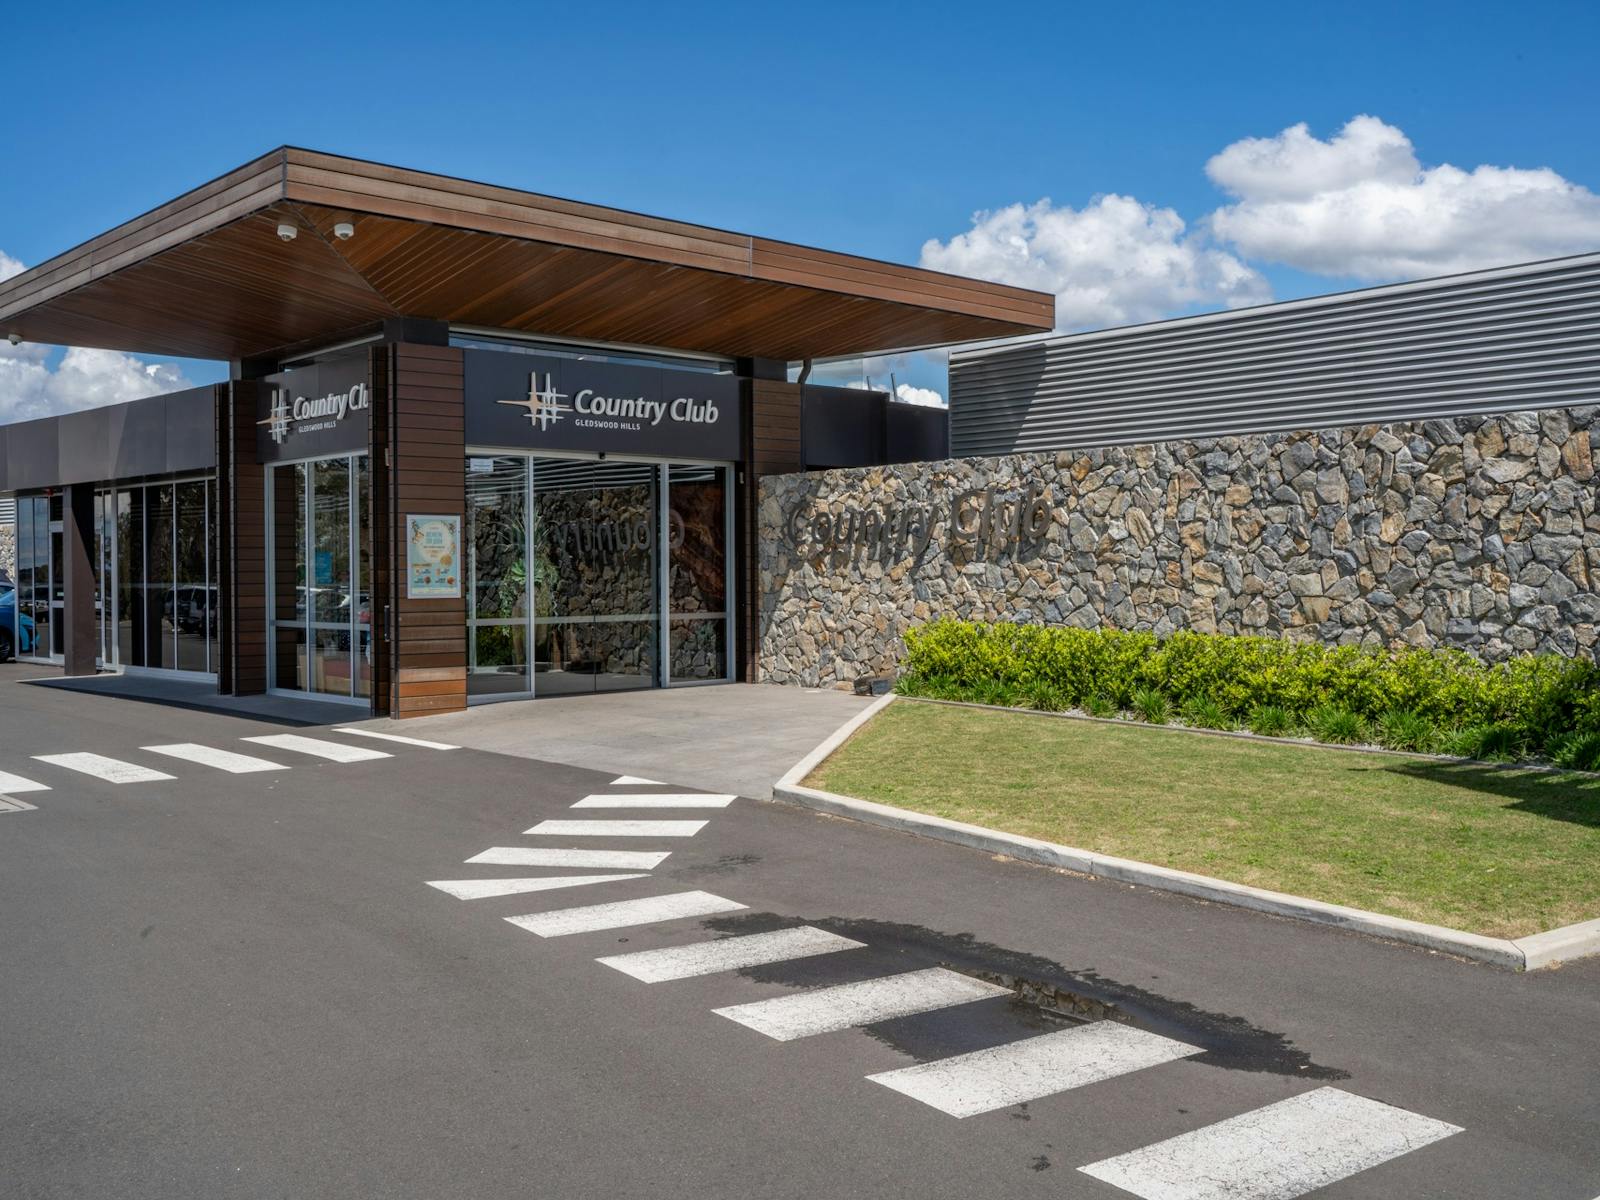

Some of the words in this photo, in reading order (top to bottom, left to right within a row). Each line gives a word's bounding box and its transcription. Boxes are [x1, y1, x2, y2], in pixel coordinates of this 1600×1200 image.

[293, 393, 348, 420] Country
[574, 389, 667, 426] Country
[670, 398, 719, 424] Club
[575, 418, 619, 429] GLEDSWOOD
[620, 422, 641, 430] HILLS
[787, 497, 939, 559] Country
[951, 484, 1052, 540] Club
